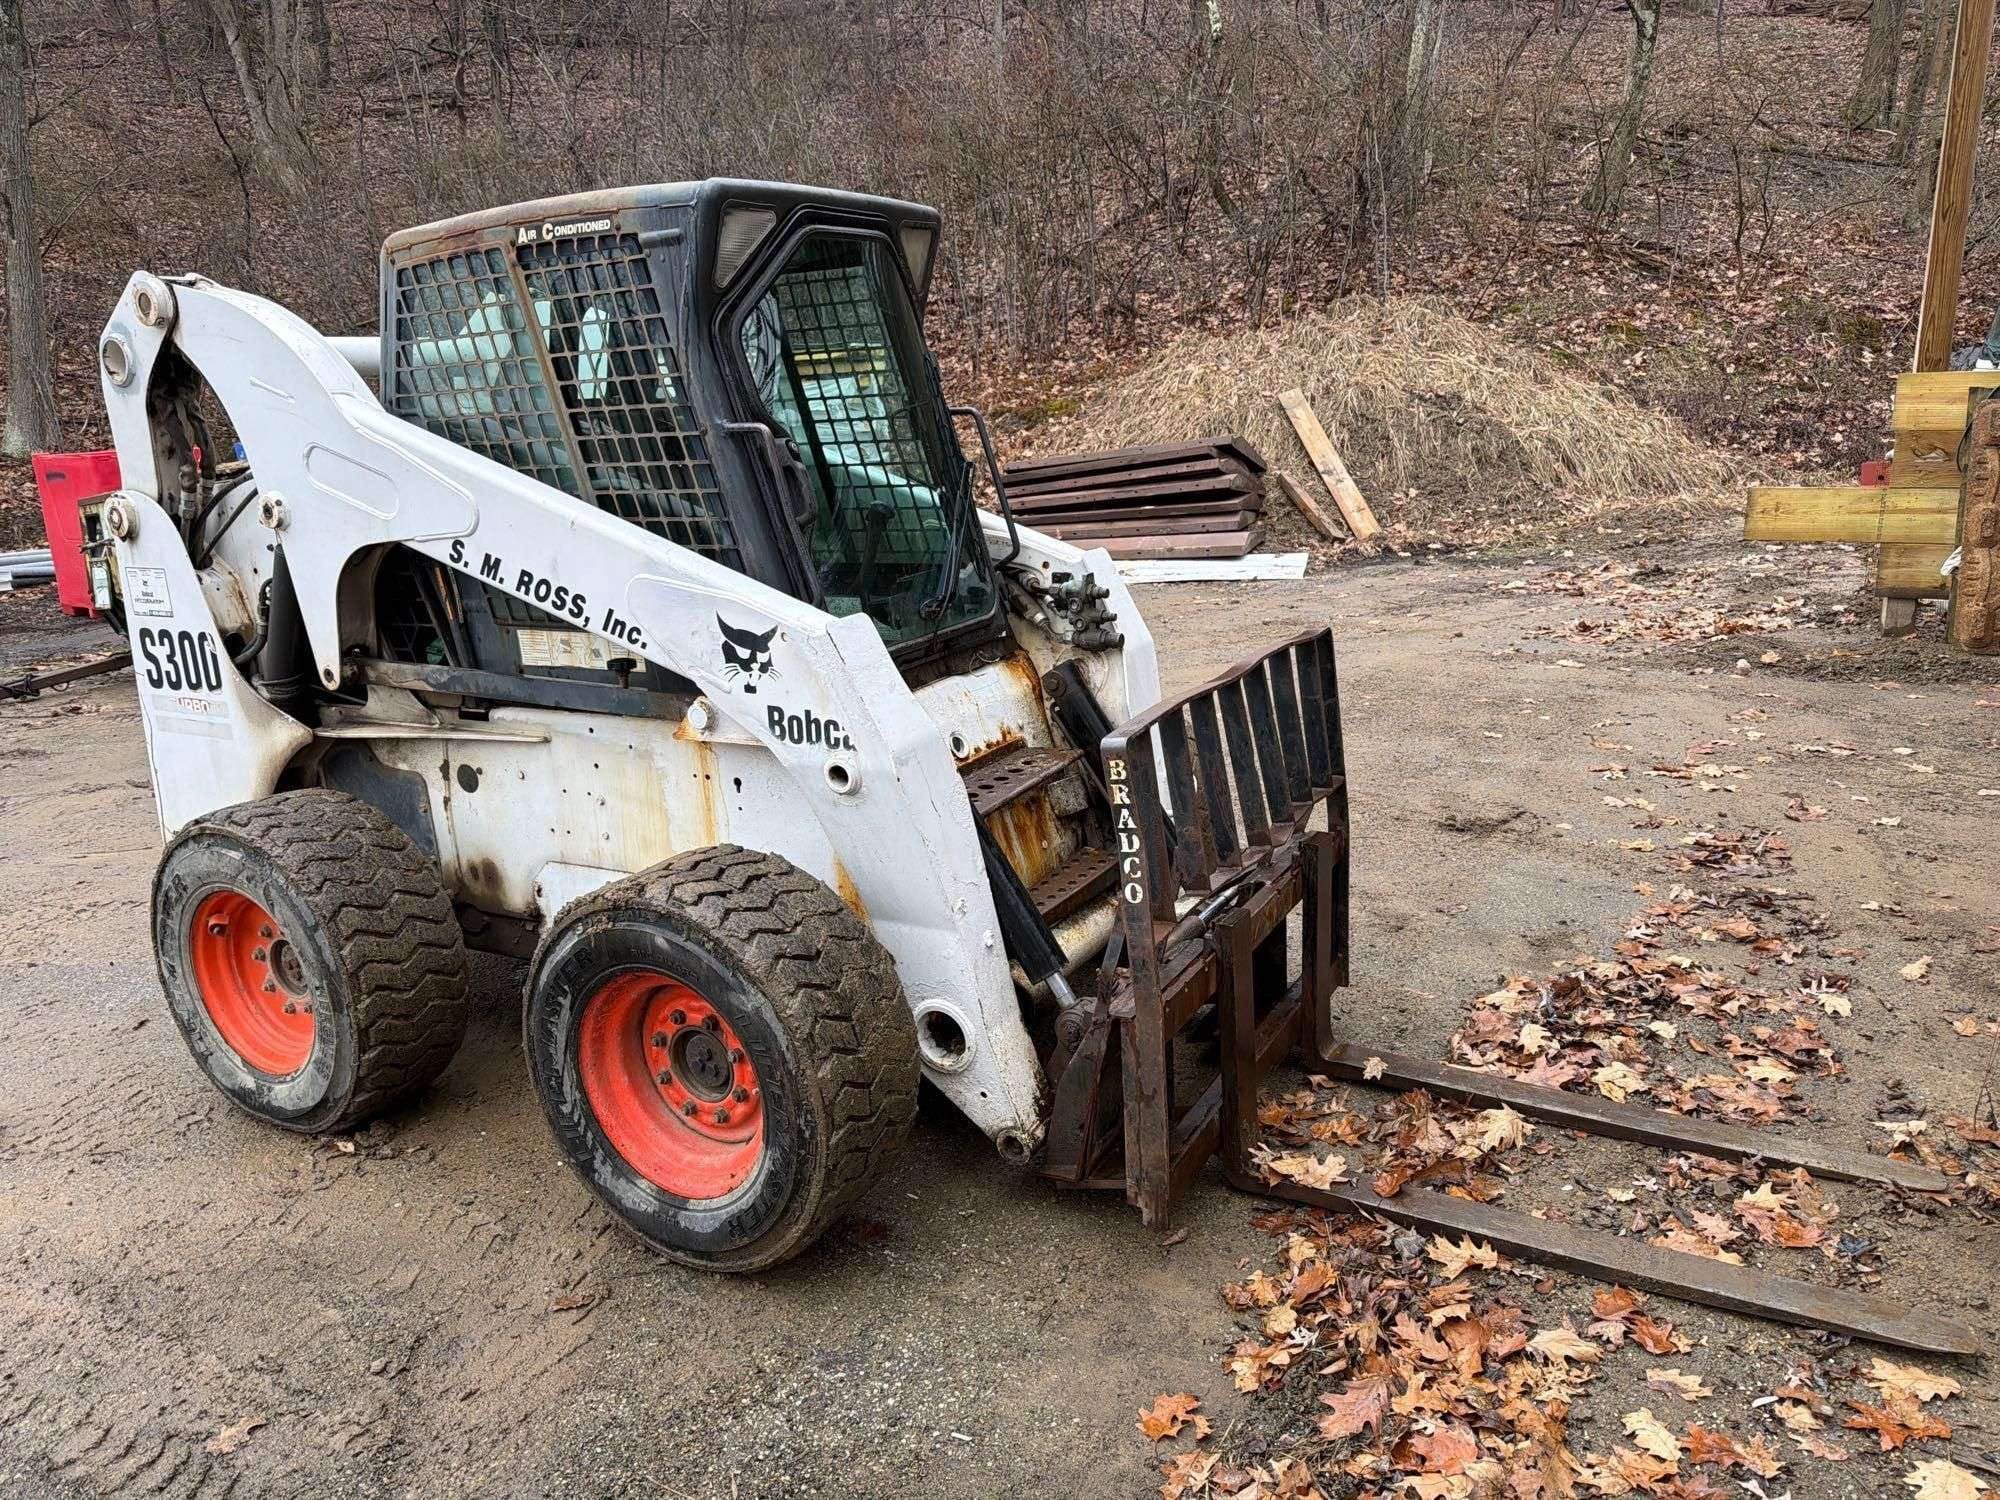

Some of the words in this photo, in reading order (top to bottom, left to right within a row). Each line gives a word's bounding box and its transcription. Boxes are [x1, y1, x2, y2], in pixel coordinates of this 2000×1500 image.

[449, 539, 469, 569] S.
[479, 552, 505, 585] M.
[515, 568, 591, 628] ROSS,
[602, 607, 648, 650] Inc.
[139, 627, 222, 692] S300
[1108, 759, 1144, 904] BRADCO
